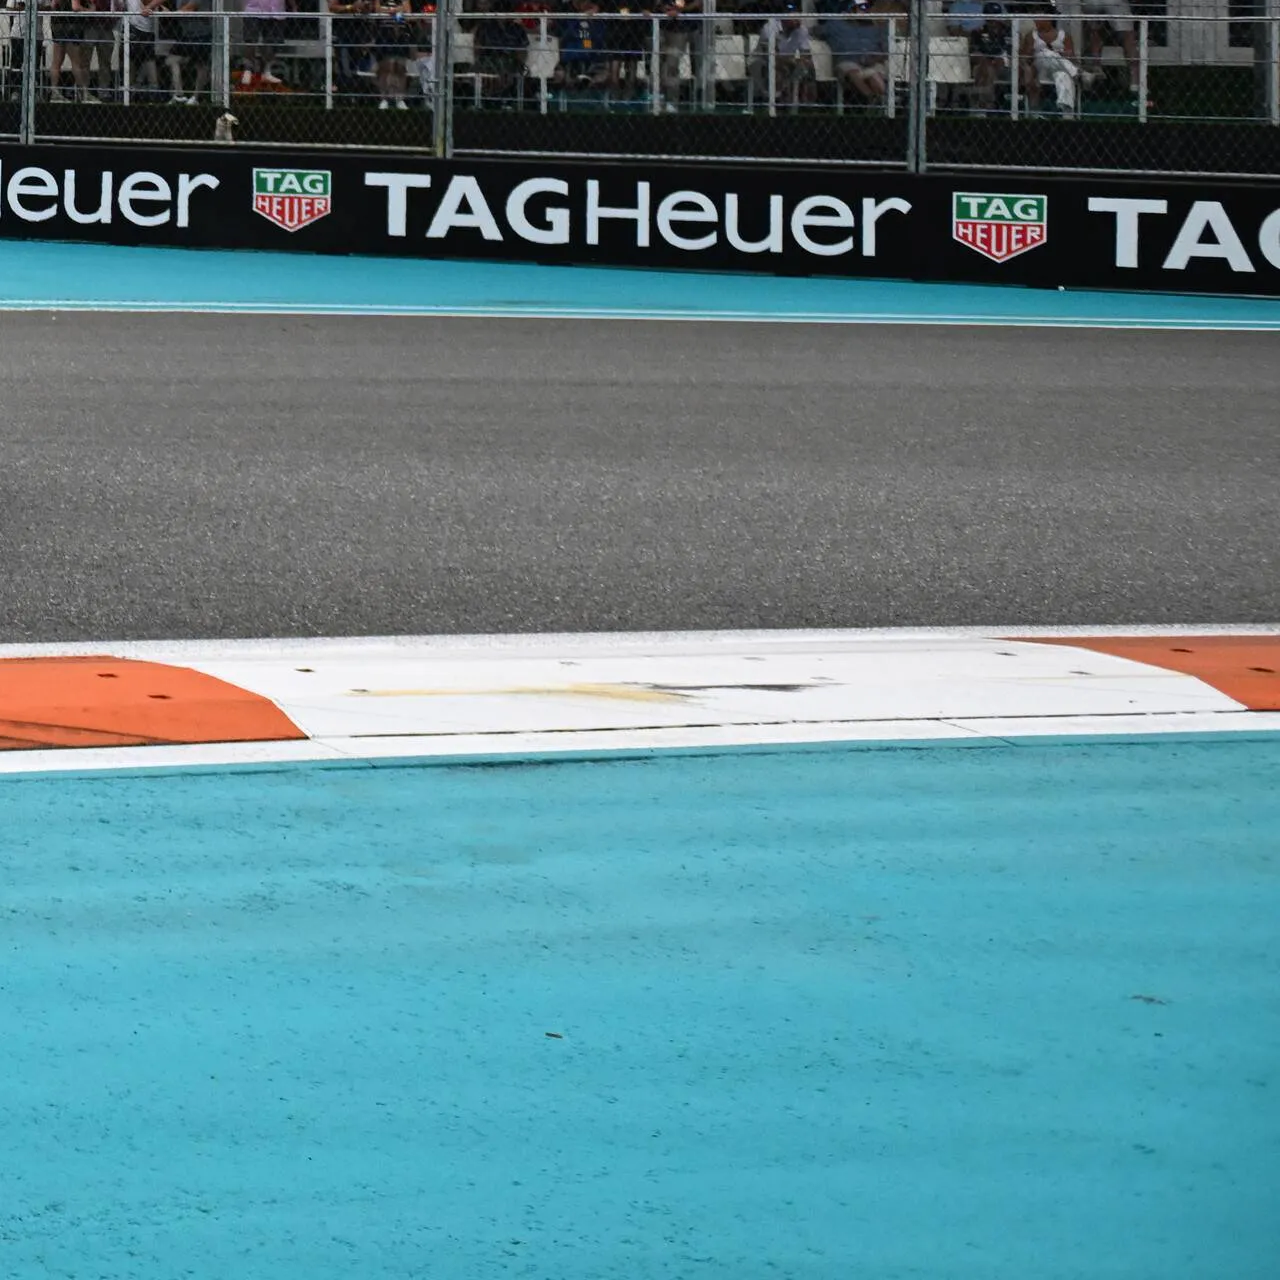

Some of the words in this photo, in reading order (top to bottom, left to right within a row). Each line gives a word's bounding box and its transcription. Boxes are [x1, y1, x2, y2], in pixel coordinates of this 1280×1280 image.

[260, 173, 324, 193] TAG
[257, 195, 327, 229] HEUER
[961, 197, 1038, 220] TAG
[956, 222, 1041, 259] HEUER
